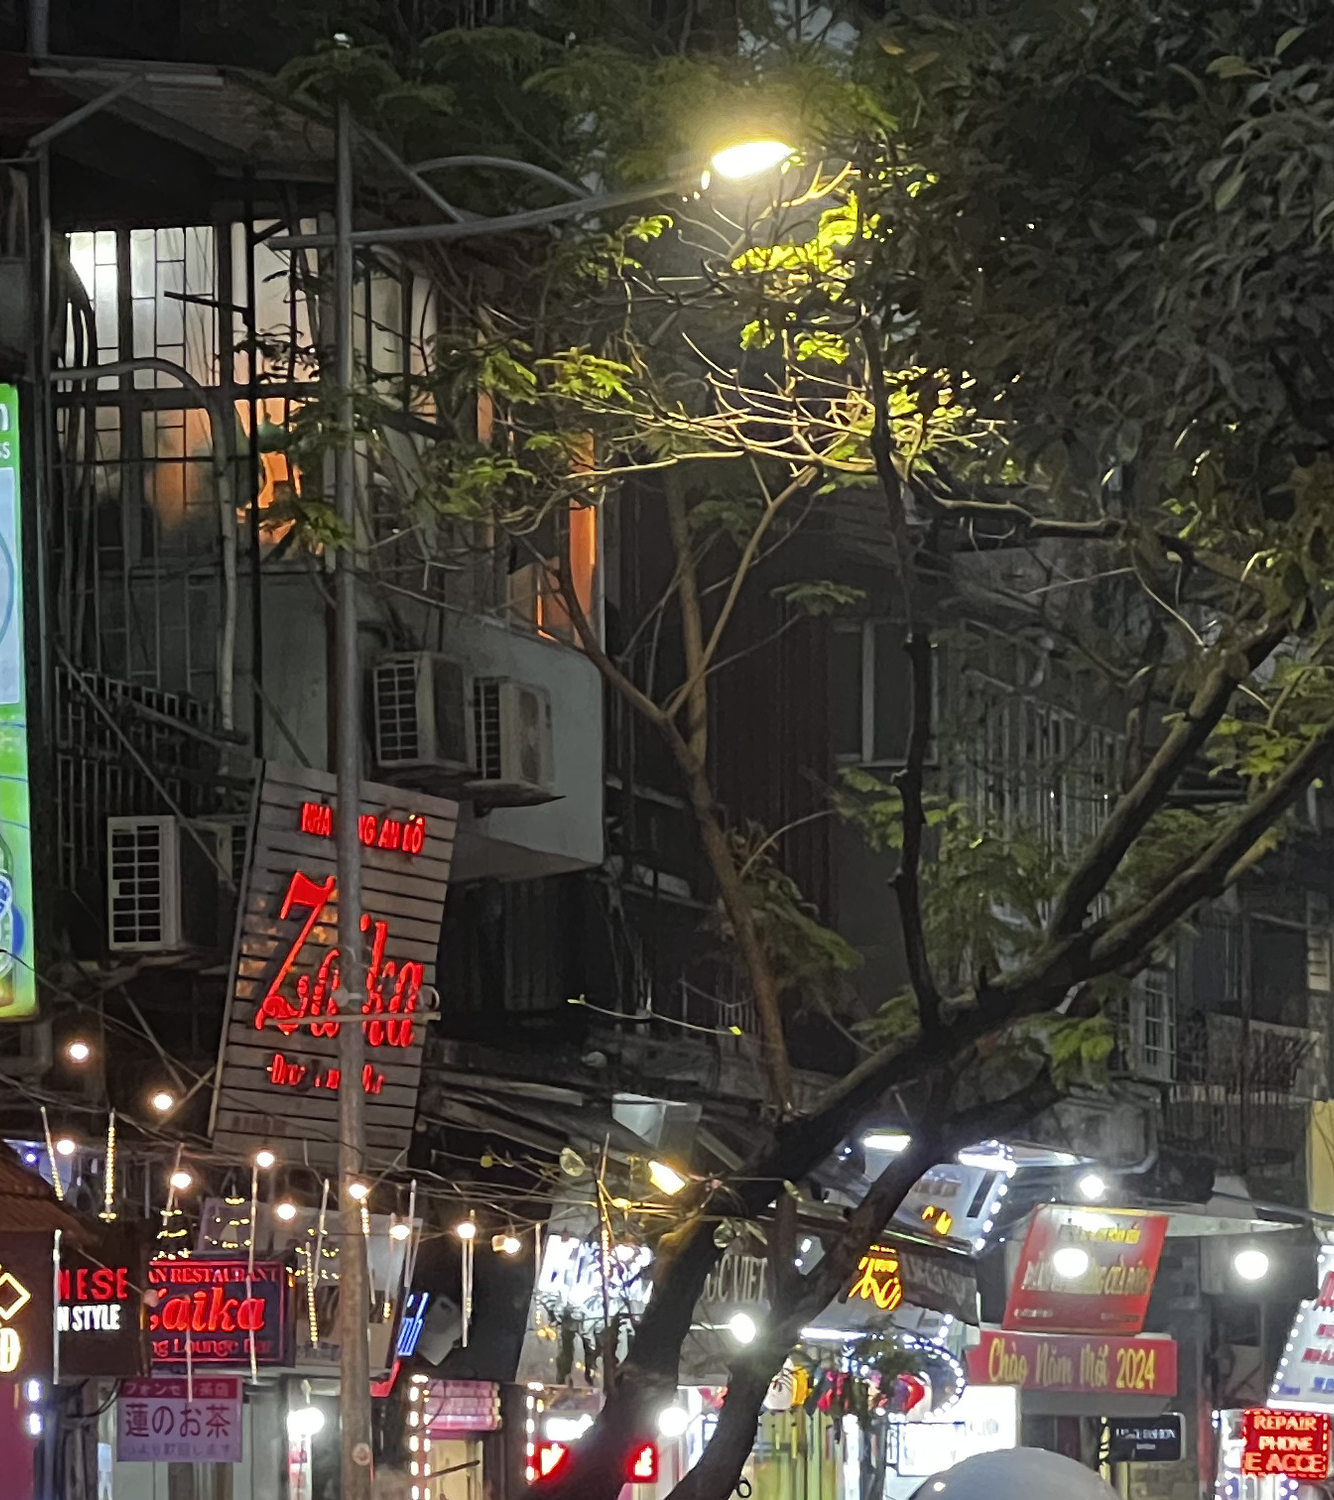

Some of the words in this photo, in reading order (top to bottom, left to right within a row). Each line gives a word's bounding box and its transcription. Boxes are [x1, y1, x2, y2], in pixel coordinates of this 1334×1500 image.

[170, 1267, 277, 1283] RESTAURANT
[71, 1304, 121, 1332] STYLE
[149, 1286, 266, 1332] aika
[988, 1337, 1029, 1385] Chào
[1035, 1342, 1073, 1387] Năm
[1116, 1348, 1155, 1389] 2024
[125, 1402, 231, 1438] 蓮のお茶
[1253, 1415, 1317, 1431] REPAIR
[1259, 1436, 1313, 1452] PHONE
